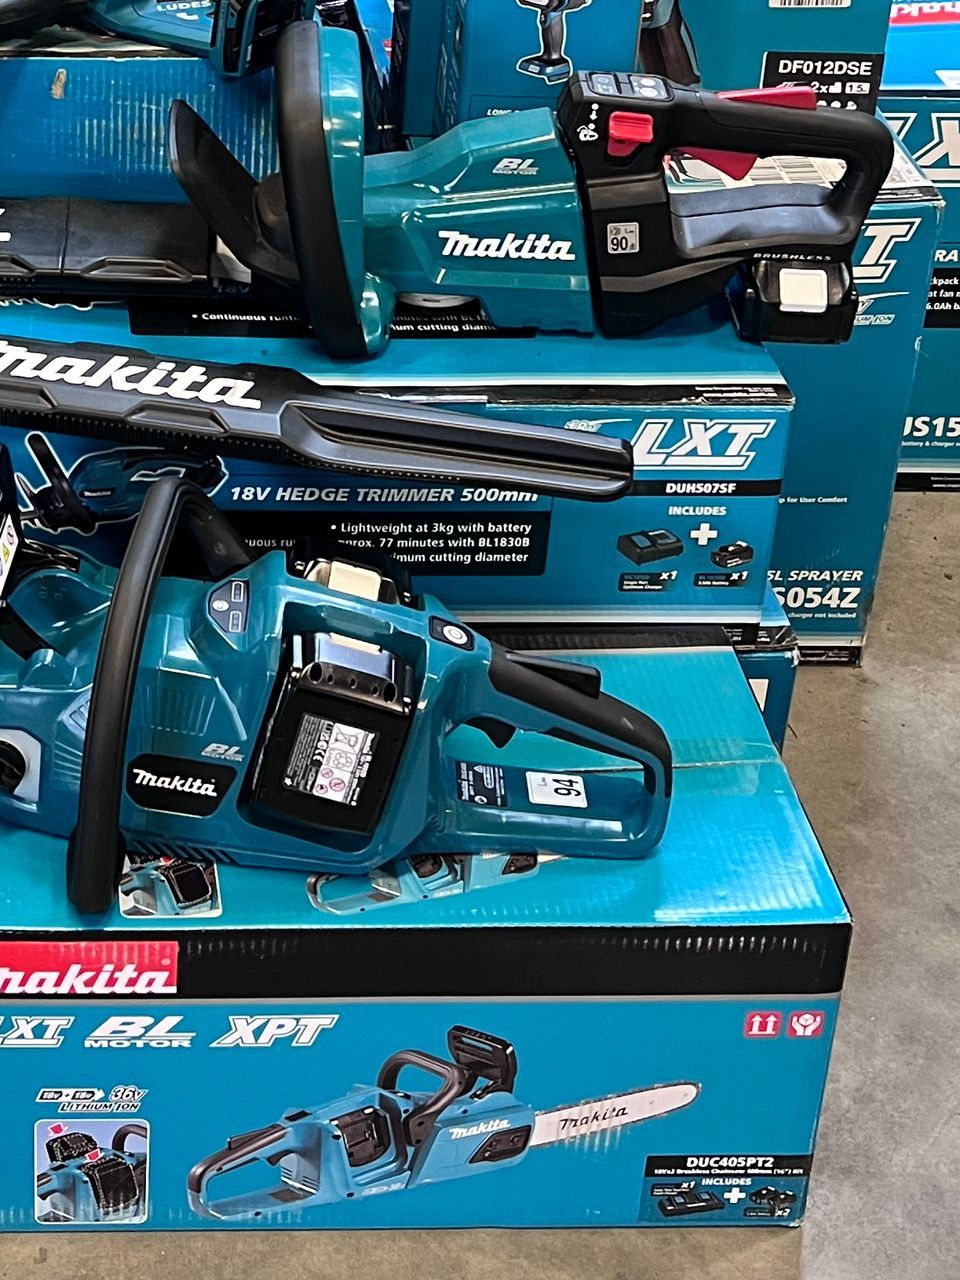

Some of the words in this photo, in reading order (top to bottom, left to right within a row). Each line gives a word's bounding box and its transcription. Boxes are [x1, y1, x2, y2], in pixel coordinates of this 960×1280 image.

[778, 59, 873, 76] DF012DSE
[496, 157, 537, 170] BL
[438, 229, 576, 261] makita
[610, 236, 629, 252] 90
[202, 311, 267, 321] Continuous
[416, 322, 459, 333] cutting
[632, 418, 776, 470] LXT
[231, 486, 272, 501] 18V
[275, 487, 351, 502] HEDGE
[356, 488, 456, 502] TRIMMER
[459, 487, 539, 502] 500mm
[665, 483, 737, 494] DUH507SF
[668, 506, 727, 516] INCLUDES
[341, 522, 413, 535] Lightweight
[415, 524, 429, 533] at
[431, 523, 454, 535] 3kg
[458, 522, 485, 533] with
[487, 523, 532, 535] battery
[379, 538, 394, 548] 77
[397, 537, 445, 548] minutes
[447, 538, 475, 548] with
[478, 537, 530, 548] BL1830B
[429, 552, 471, 564] cutting
[474, 552, 529, 562] diameter
[788, 570, 864, 582] SPRAYER
[132, 768, 218, 797] makita
[553, 777, 582, 798] 94
[88, 1015, 198, 1038] BL
[209, 1014, 340, 1047] XPT
[84, 1038, 192, 1048] MOTOR
[686, 1157, 775, 1168] DUC405PT2
[701, 1177, 753, 1186] INCLUDES
